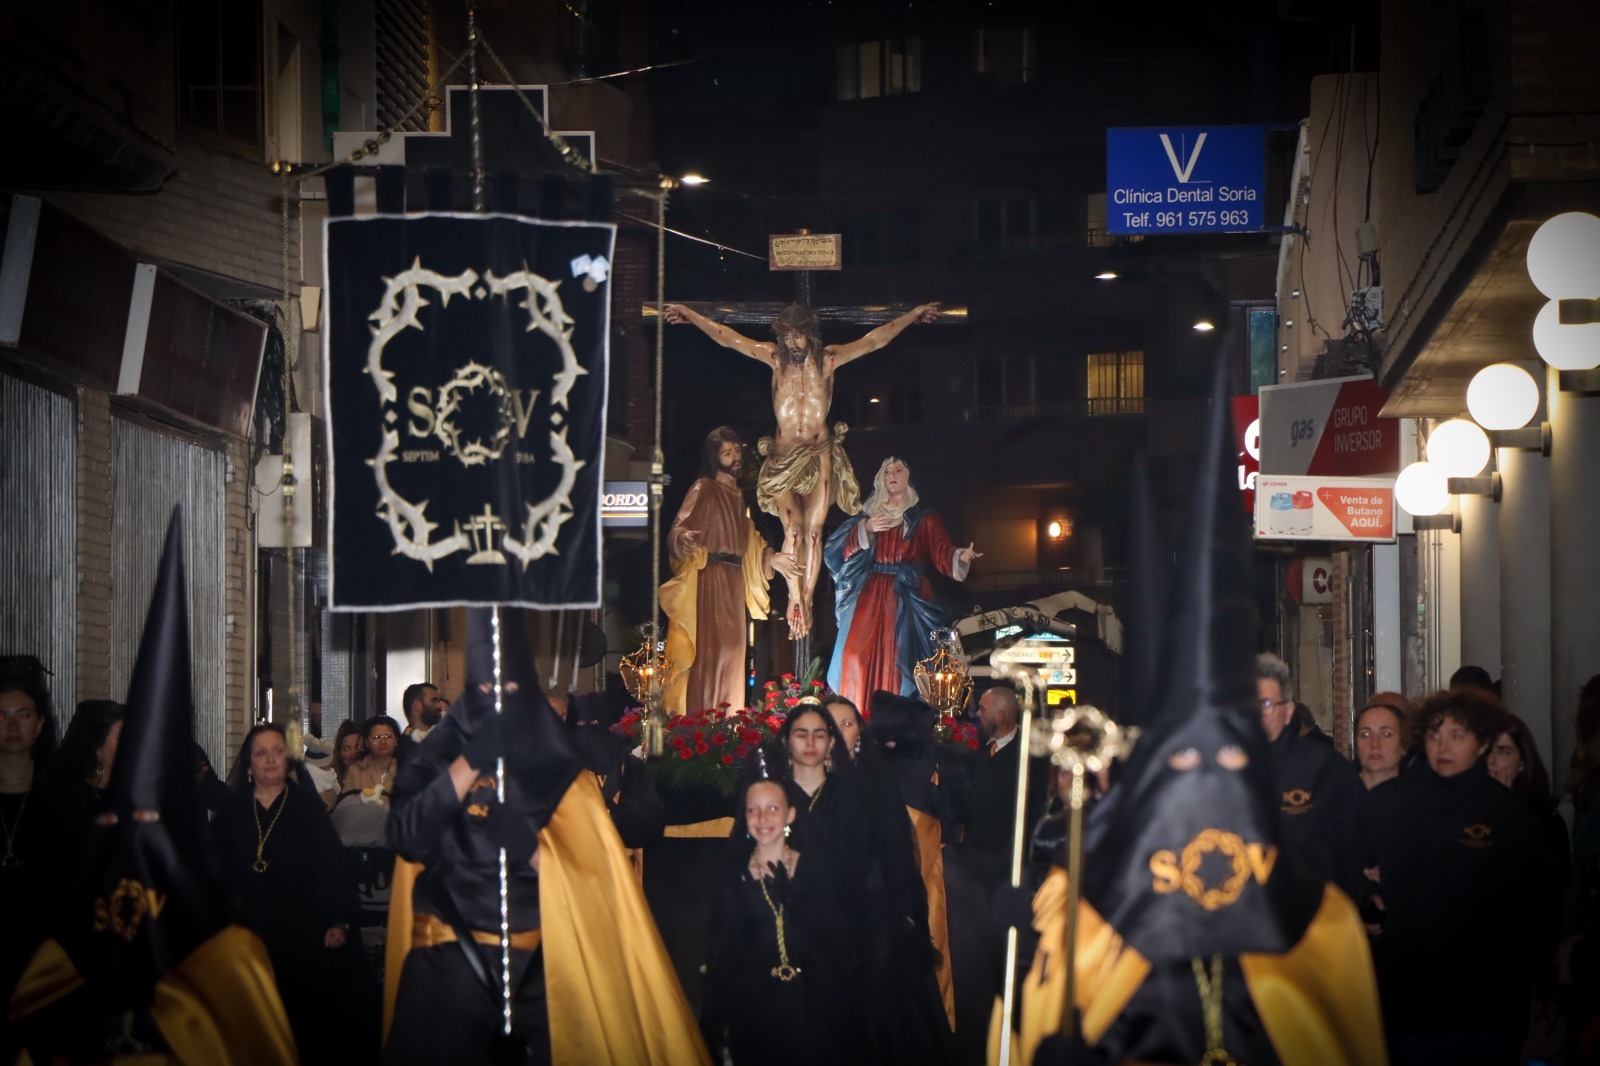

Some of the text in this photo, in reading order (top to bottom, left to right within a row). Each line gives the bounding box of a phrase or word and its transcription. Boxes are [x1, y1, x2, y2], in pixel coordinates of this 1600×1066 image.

[1114, 186, 1257, 204] Clínica Dental Soria
[1123, 210, 1249, 227] Telf. 961 575 963
[1334, 405, 1368, 428] GRUPO
[1291, 418, 1315, 448] gas
[1334, 430, 1382, 453] INVERSOR
[1340, 495, 1383, 505] Venta de
[1347, 506, 1383, 516] Butano
[1350, 517, 1383, 528] AQUÍ.
